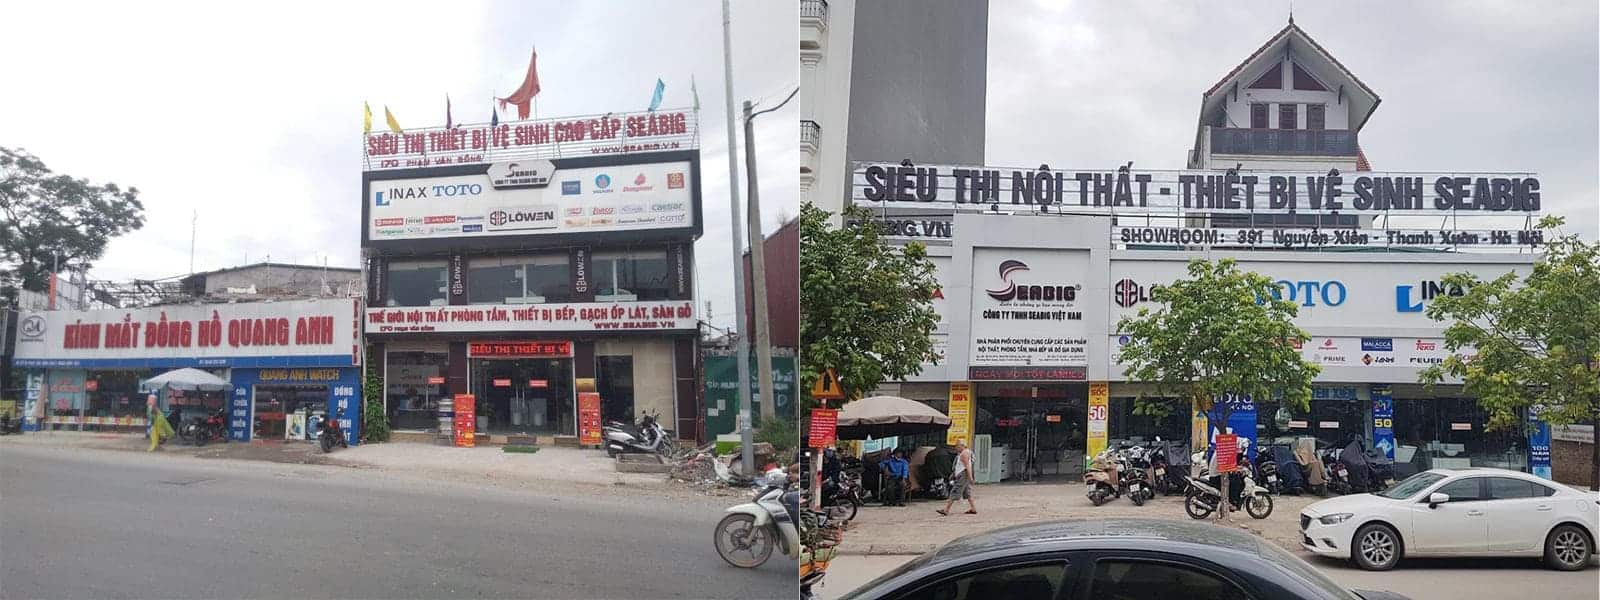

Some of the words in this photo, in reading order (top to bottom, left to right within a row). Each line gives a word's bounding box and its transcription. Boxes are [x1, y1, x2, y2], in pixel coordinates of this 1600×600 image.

[368, 132, 398, 156] SIÊU
[402, 133, 425, 155] THỊ
[428, 123, 467, 152] THIẾT
[472, 128, 487, 151] BỊ
[515, 124, 549, 146] SINH
[554, 121, 585, 143] CAO
[626, 112, 686, 138] SEABIG
[389, 186, 427, 200] INAX
[432, 184, 482, 198] TOTO
[863, 158, 938, 202] SIÊU
[953, 168, 1000, 212] THỊ
[1011, 164, 1063, 214] NỘI
[1076, 161, 1152, 207] THẤT
[1179, 163, 1258, 210] THIẾT
[1269, 175, 1297, 216] BỊ
[1306, 168, 1343, 216] VỆ
[1353, 176, 1423, 211] SINH
[1434, 176, 1541, 212] SEABIG
[1121, 228, 1225, 245] SHOWROOM:
[1386, 230, 1434, 245] Thanh
[368, 309, 385, 323] THẾ
[407, 309, 422, 324] NỘI
[425, 307, 448, 322] THẤT
[451, 308, 483, 323] PHÒNG
[512, 305, 539, 321] THIẾT
[542, 309, 552, 322] BỊ
[555, 305, 577, 322] BẾP,
[580, 307, 608, 321] GẠCH
[611, 304, 625, 319] ỐP
[628, 306, 649, 320] LÁT,
[652, 304, 674, 319] SÀN
[983, 309, 1000, 320] CÔNG
[1001, 311, 1010, 320] TY
[1011, 311, 1028, 320] TNHH
[1029, 311, 1051, 320] SEABIG
[1052, 309, 1066, 322] VIỆT
[1067, 312, 1082, 320] NAM
[64, 319, 101, 349] KÍNH
[105, 313, 140, 348] MẮT
[144, 312, 192, 348] ĐỒNG
[198, 309, 222, 347] HỒ
[228, 318, 289, 348] QUANG
[295, 316, 333, 345] ANH
[1374, 418, 1392, 428] 50
